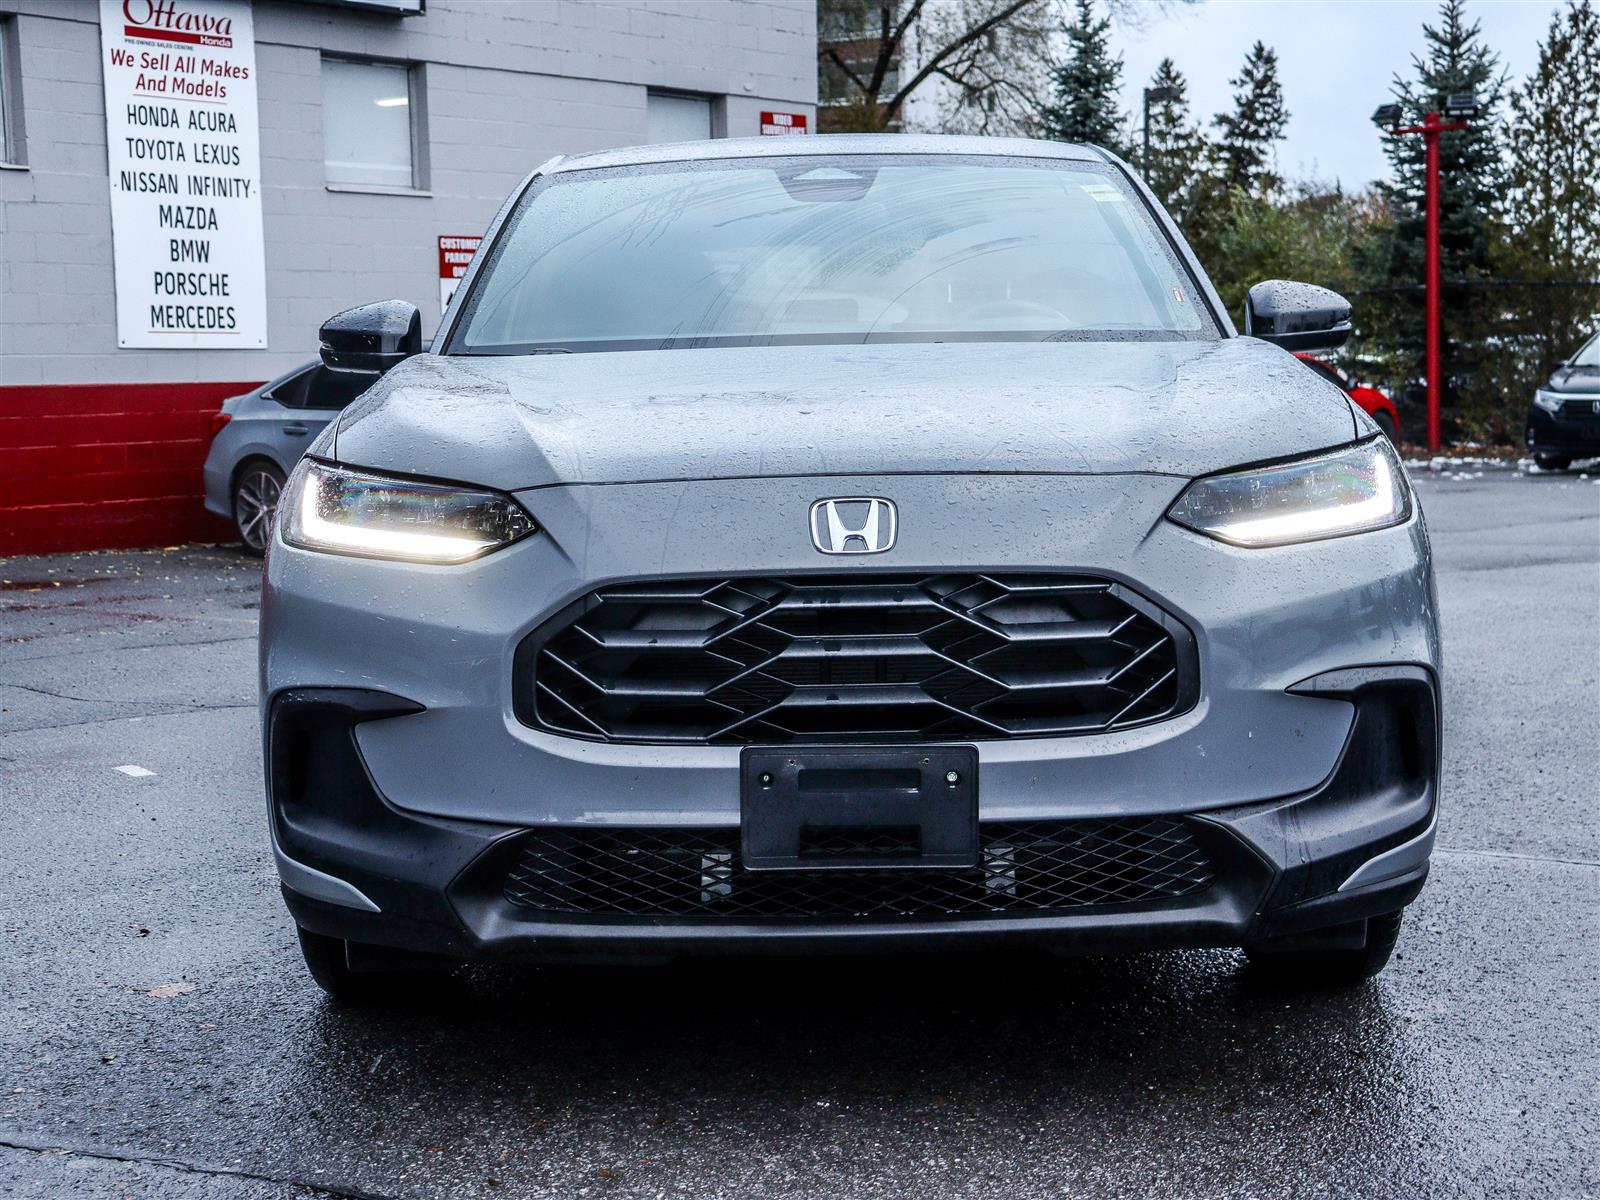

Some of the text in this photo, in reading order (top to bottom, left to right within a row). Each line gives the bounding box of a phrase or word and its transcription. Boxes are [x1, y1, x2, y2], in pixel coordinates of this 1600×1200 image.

[122, 0, 233, 36] Ottawa
[200, 36, 232, 47] Honda
[111, 48, 249, 79] We Sell All Makes
[136, 73, 226, 98] And Models
[127, 103, 237, 133] HONDA ACURA
[126, 137, 240, 166] TOYOTA LEXUS
[121, 170, 251, 198] NISSAN INFINITY
[159, 204, 218, 231] MAZDA
[170, 239, 210, 263] BMW
[154, 271, 230, 297] PORSCHE
[151, 305, 236, 329] MERCEDES
